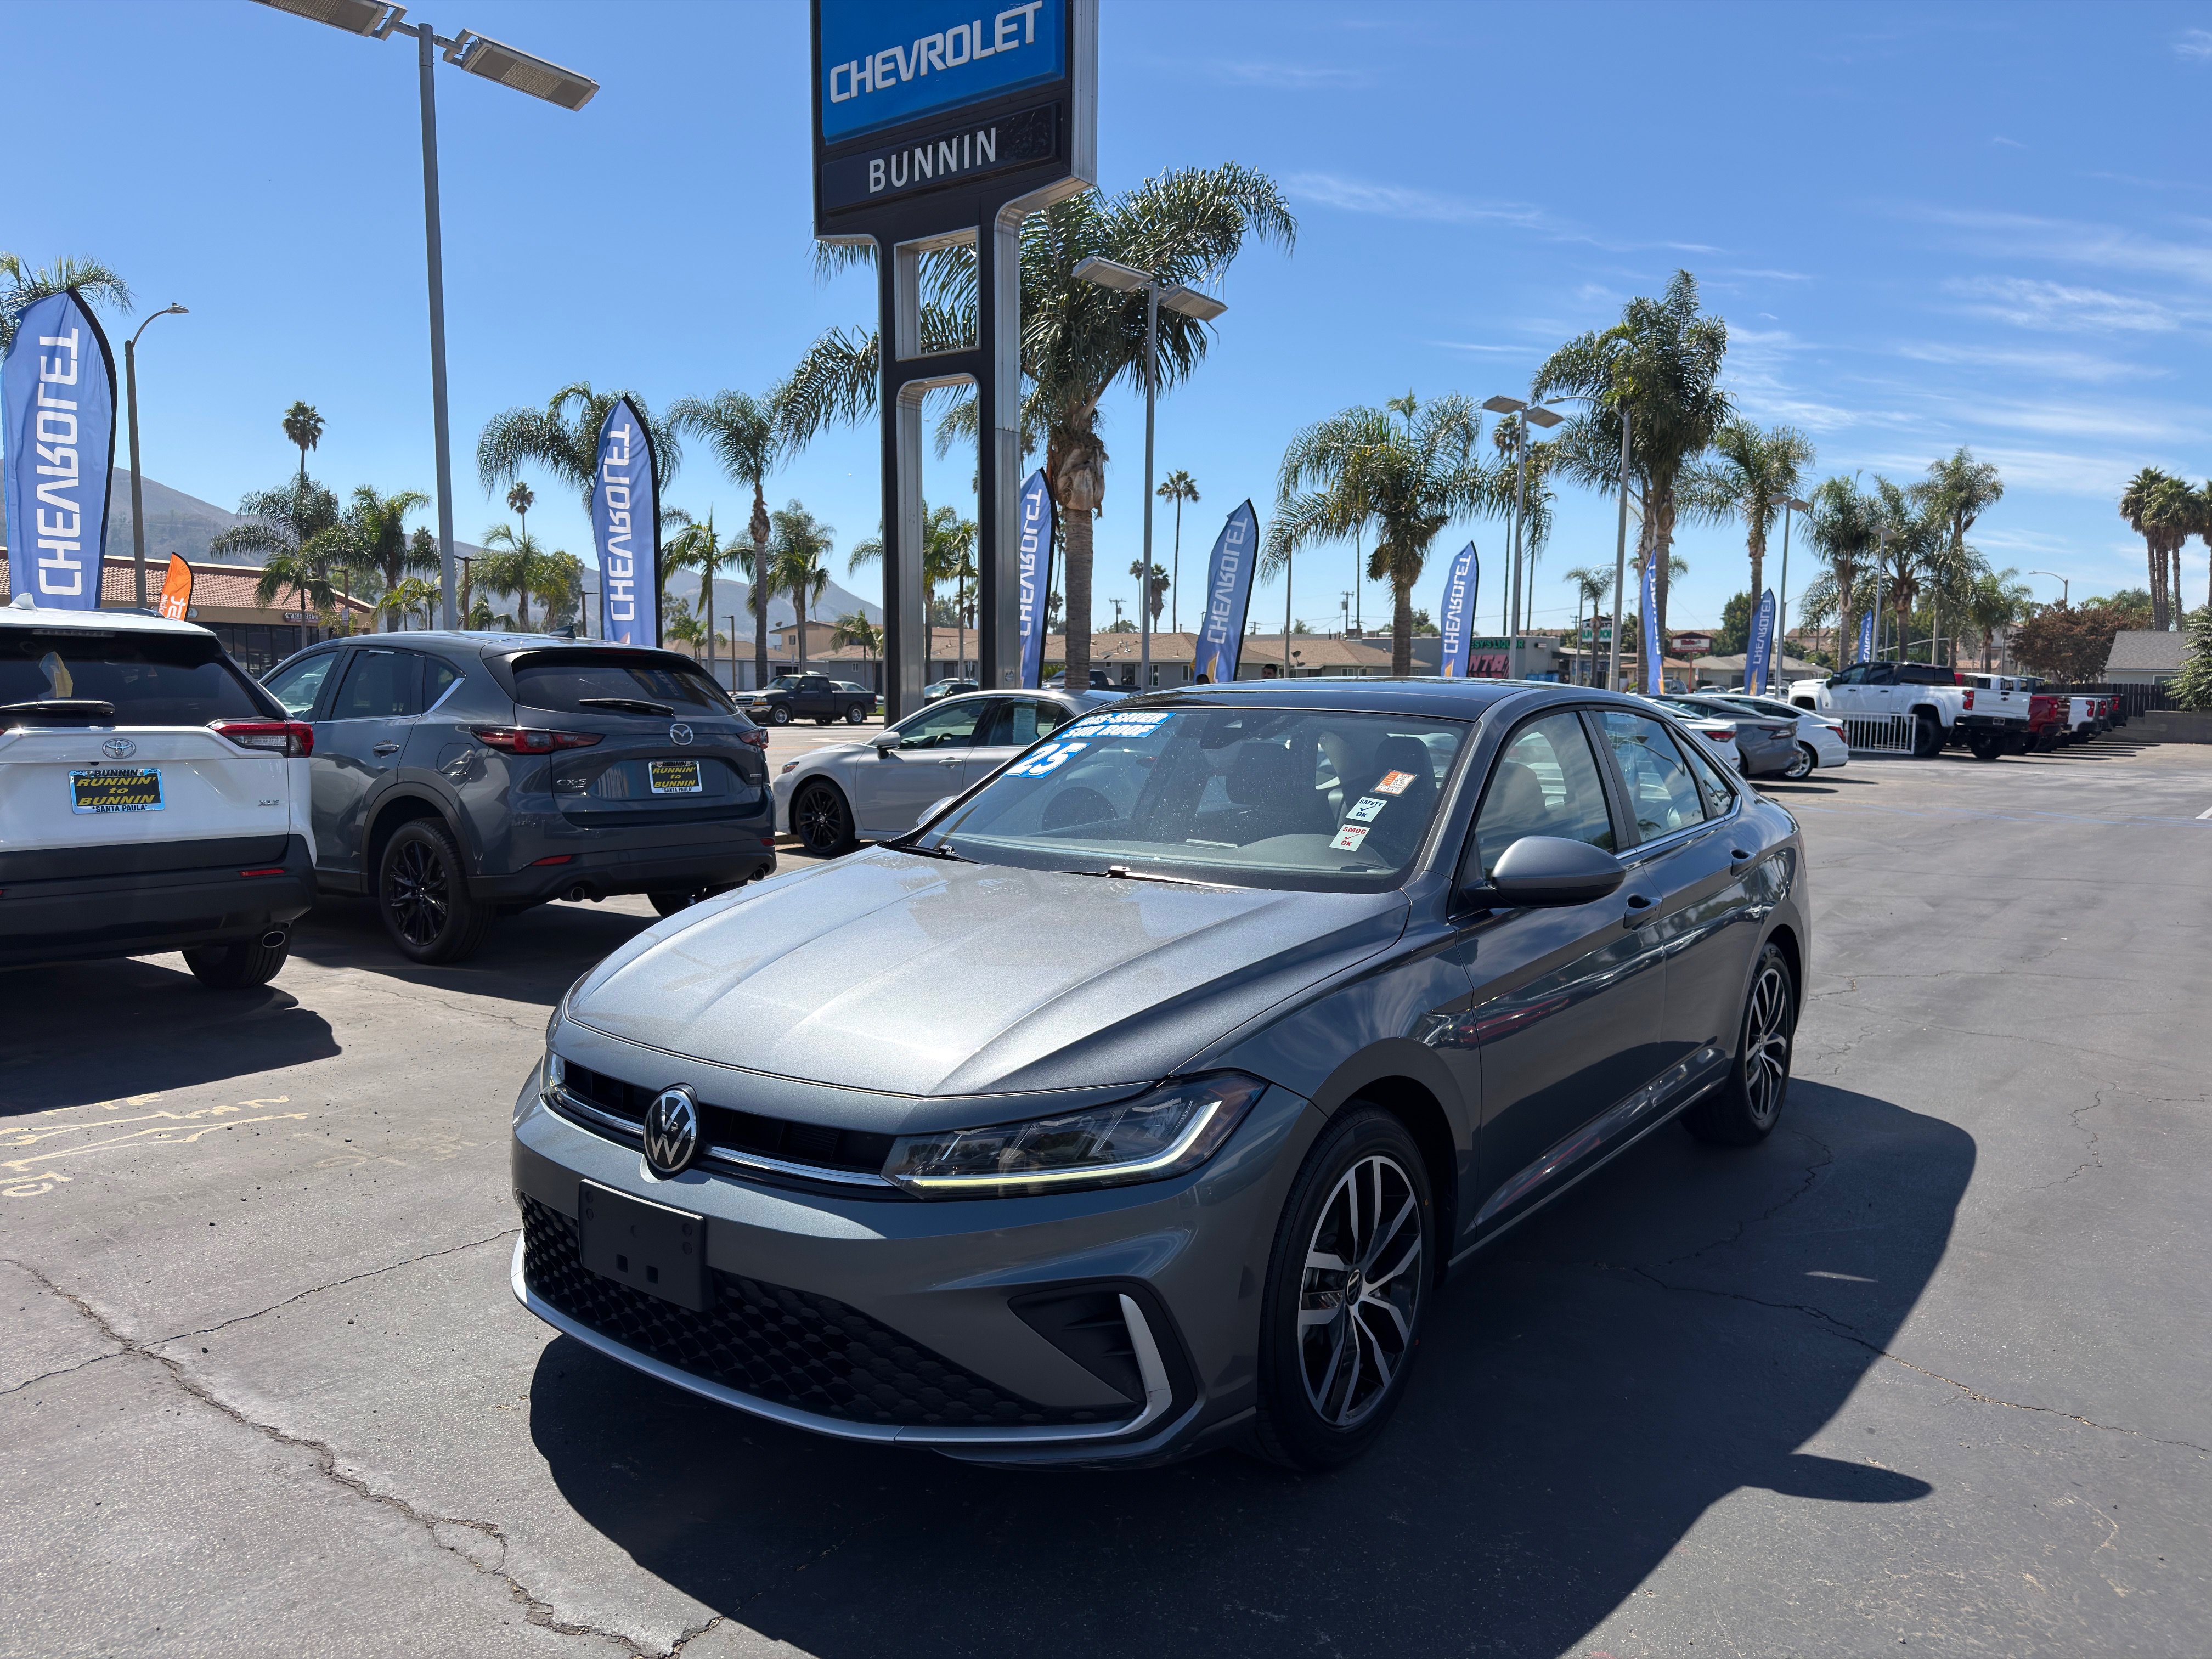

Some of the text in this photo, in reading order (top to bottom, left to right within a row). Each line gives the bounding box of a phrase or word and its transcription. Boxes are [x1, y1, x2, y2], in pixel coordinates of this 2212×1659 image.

[830, 0, 1042, 103] CHEVROLET
[869, 127, 996, 193] BUNNIN
[1493, 640, 1523, 648] LIQUR
[1062, 724, 1155, 738] SUN ROOF
[1005, 743, 1088, 775] 25
[94, 769, 138, 777] BUNNIN
[76, 777, 157, 787] RUNNIN'
[77, 795, 155, 806] BUNNIN
[1359, 799, 1383, 807] SAFETY
